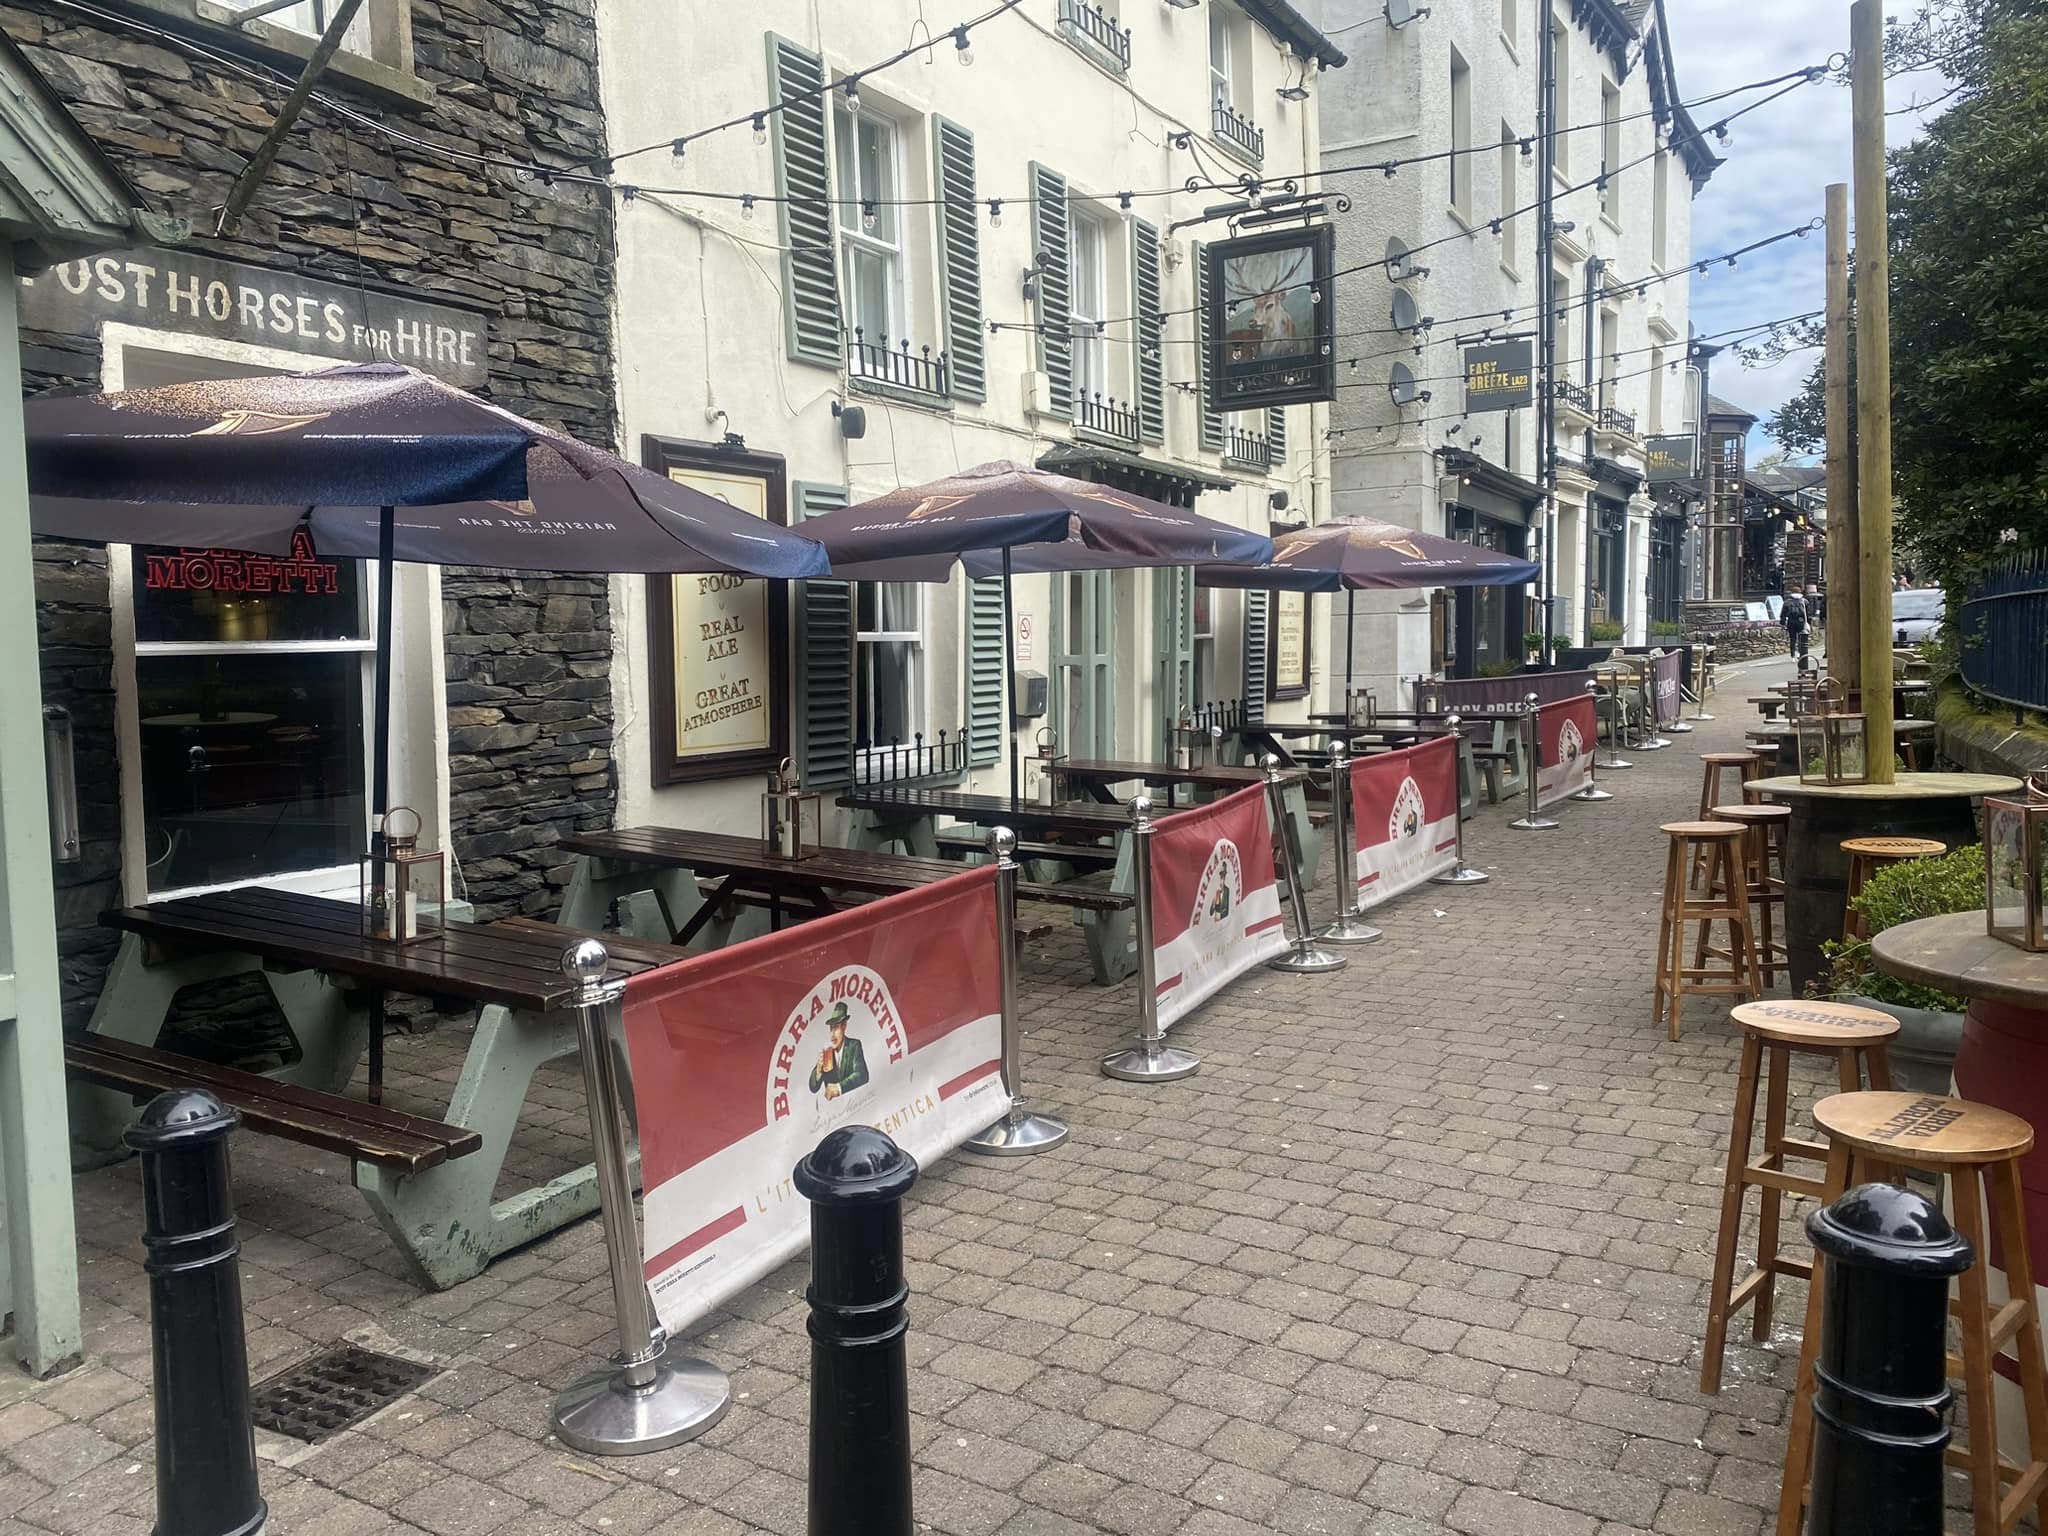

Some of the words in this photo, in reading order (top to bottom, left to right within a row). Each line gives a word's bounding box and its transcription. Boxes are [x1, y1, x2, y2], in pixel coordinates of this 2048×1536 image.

[22, 257, 156, 308] OST
[167, 271, 346, 343] HORSES
[353, 324, 398, 361] FOR
[397, 318, 476, 367] HIRE
[1469, 361, 1497, 375] EASY
[1469, 373, 1509, 390] BREEZE
[1511, 375, 1528, 386] LA23
[145, 555, 338, 594] MORETTI
[697, 573, 744, 596] FOOD
[700, 615, 745, 642] REAL
[706, 638, 739, 662] ALE
[695, 678, 750, 709] GREAT
[683, 695, 762, 732] ATMOSPHERE
[1192, 853, 1219, 927] BIRRA
[773, 994, 825, 1121] BIRRA
[828, 973, 903, 1064] MORETTI
[1868, 1097, 1946, 1139] MORETTI
[1903, 1108, 1966, 1137] BIRRA
